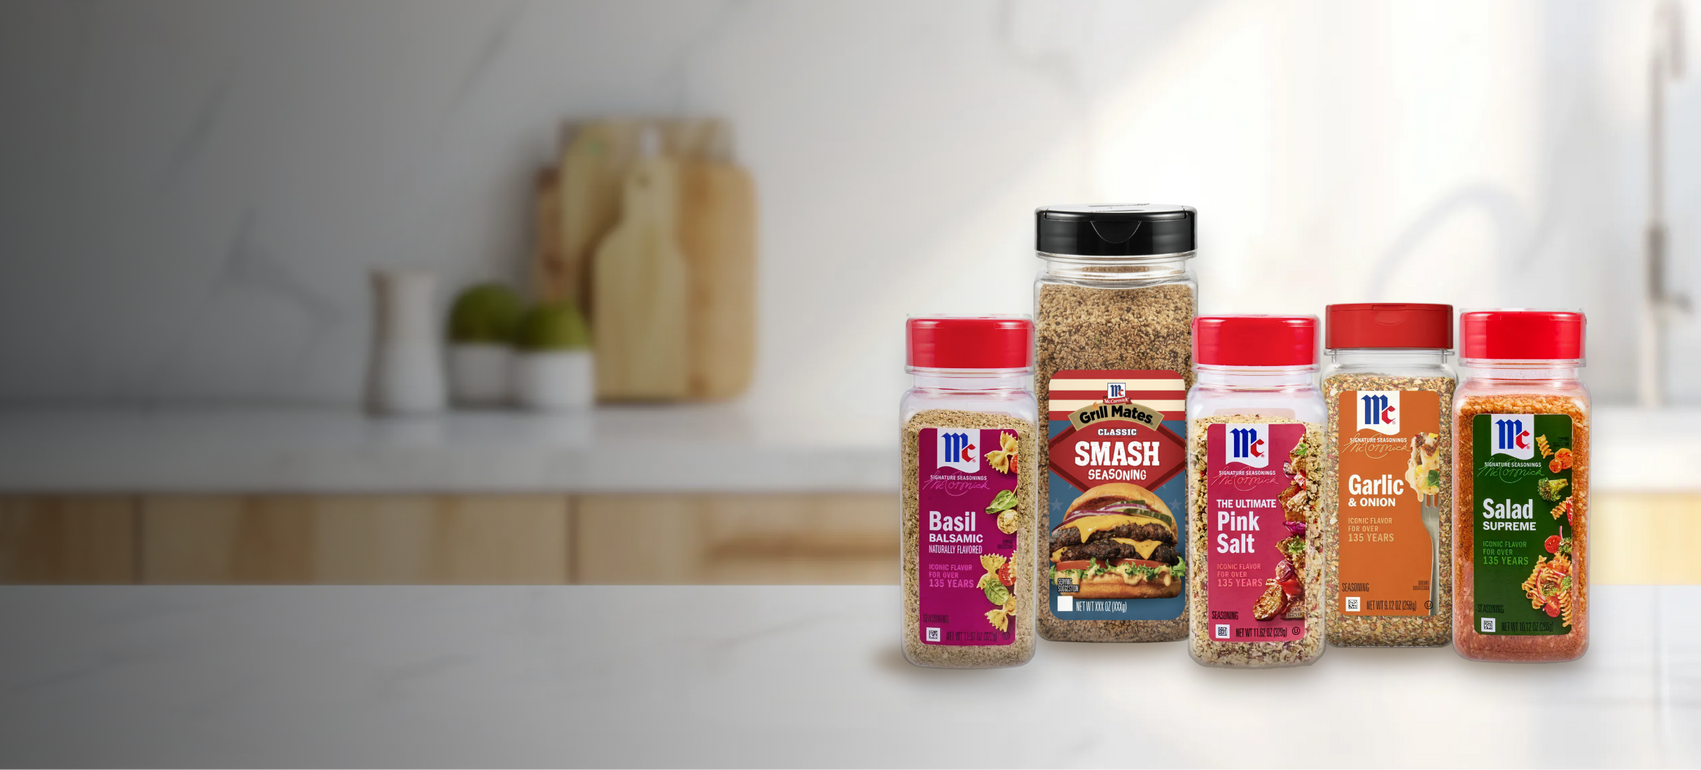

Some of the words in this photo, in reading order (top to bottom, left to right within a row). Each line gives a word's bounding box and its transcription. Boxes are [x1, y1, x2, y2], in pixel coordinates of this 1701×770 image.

[1080, 406, 1108, 424] Grill
[1112, 406, 1153, 424] Mates
[1074, 441, 1160, 466] SMASH
[1088, 468, 1147, 480] SEASONING
[1348, 474, 1404, 495] Garlic
[1217, 500, 1233, 508] THE
[1236, 500, 1276, 508] ULTIMATE
[1348, 498, 1356, 507] &
[1360, 498, 1396, 507] ONION
[1483, 498, 1533, 519] Salad
[929, 511, 976, 531] Basil
[1218, 511, 1260, 531] Pink
[1483, 522, 1536, 531] SUPREME
[929, 534, 984, 543] BALSAMIC
[1348, 533, 1364, 542] 135
[1367, 533, 1394, 542] YEARS
[1217, 533, 1255, 553] Salt
[929, 545, 956, 554] NATURALLY
[957, 545, 983, 554] FLAVORED
[1483, 556, 1498, 565] 135
[1502, 556, 1528, 565] YEARS
[929, 579, 944, 587] 135
[948, 579, 974, 588] YEARS
[1342, 583, 1369, 592] SEASONING
[1076, 601, 1086, 611] NET
[1086, 601, 1094, 611] WT
[1095, 601, 1104, 611] XXX
[1105, 601, 1111, 611] OZ
[1367, 600, 1375, 610] NET
[1376, 600, 1383, 610] WT
[1395, 600, 1401, 610] OZ
[1212, 611, 1238, 620] SEASONING
[1502, 622, 1510, 631] NET
[1511, 622, 1519, 631] WT
[1236, 628, 1244, 637] NET
[1245, 628, 1253, 637] WT
[1266, 628, 1272, 637] OZ
